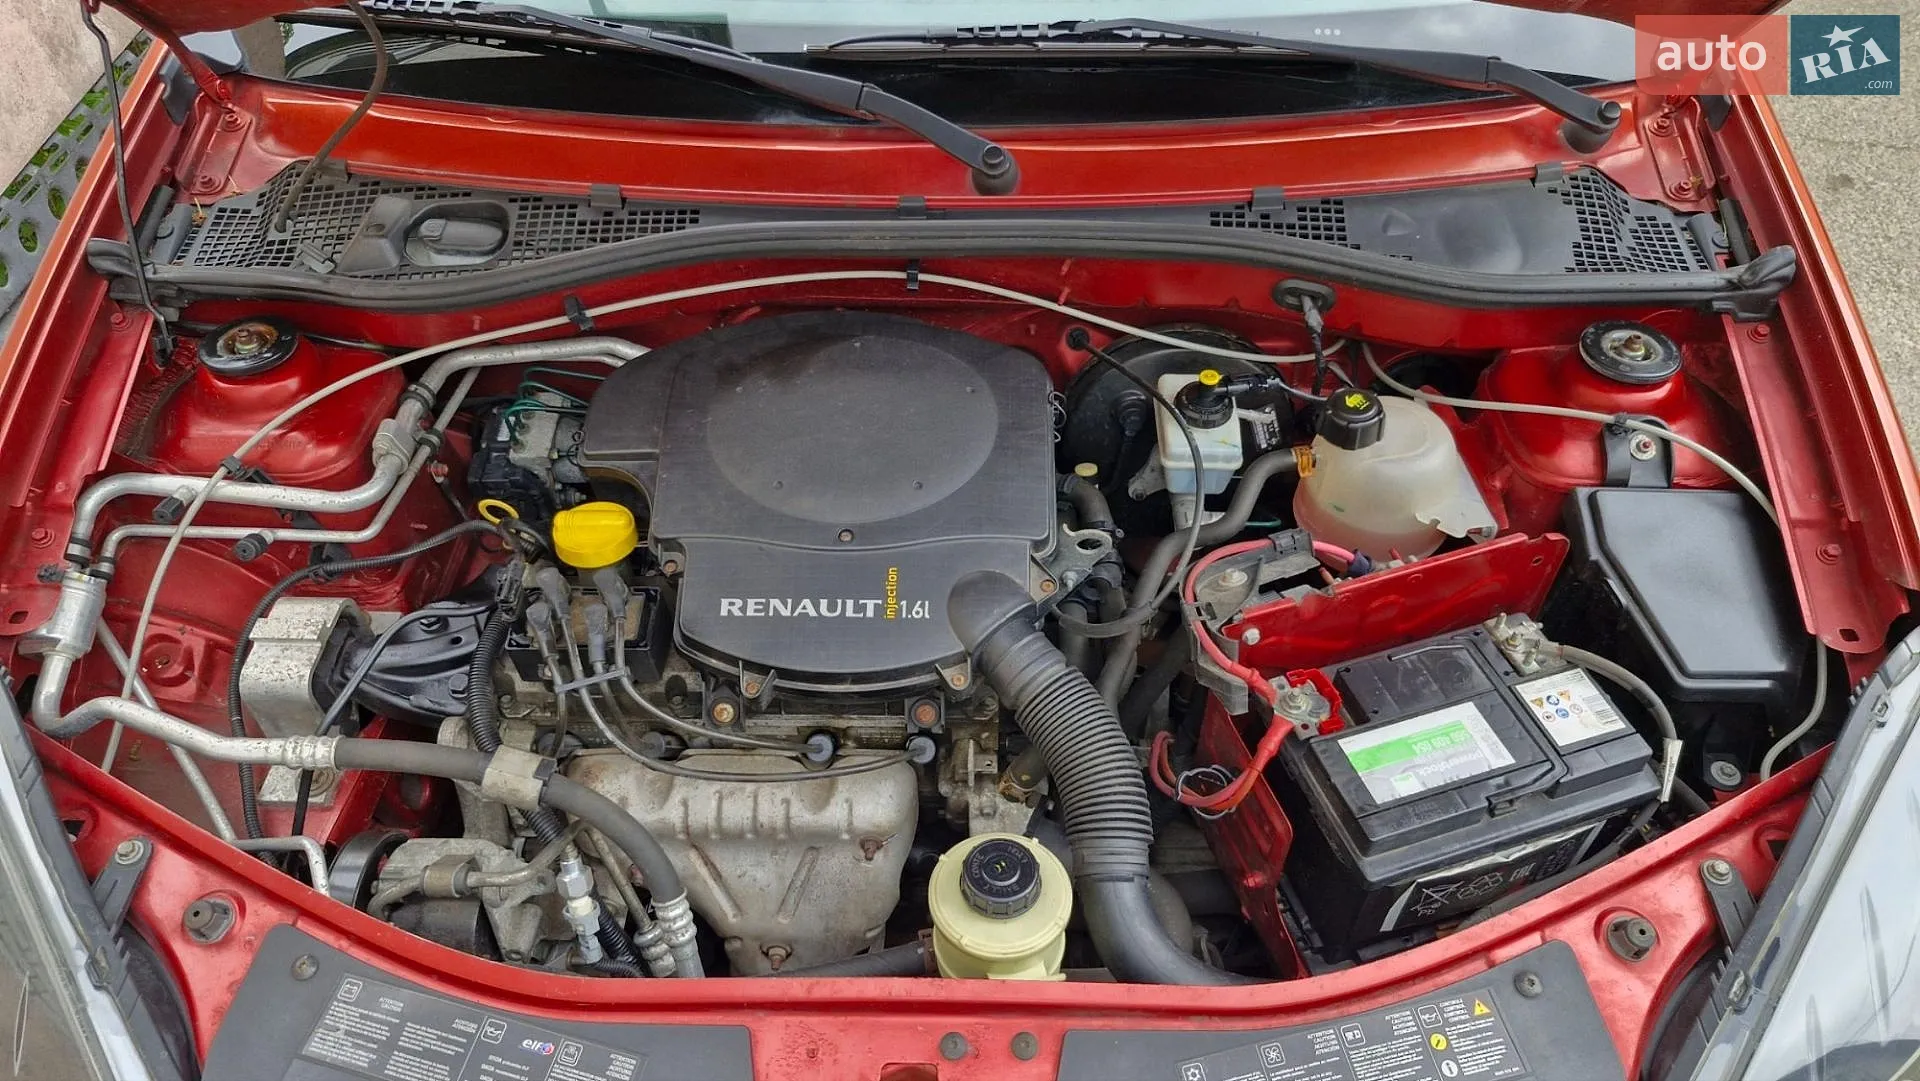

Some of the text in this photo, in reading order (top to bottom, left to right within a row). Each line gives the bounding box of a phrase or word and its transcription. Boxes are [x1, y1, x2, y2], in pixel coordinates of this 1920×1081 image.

[884, 566, 898, 619] injection
[719, 598, 882, 617] RENAULT
[521, 1038, 542, 1051] elf
